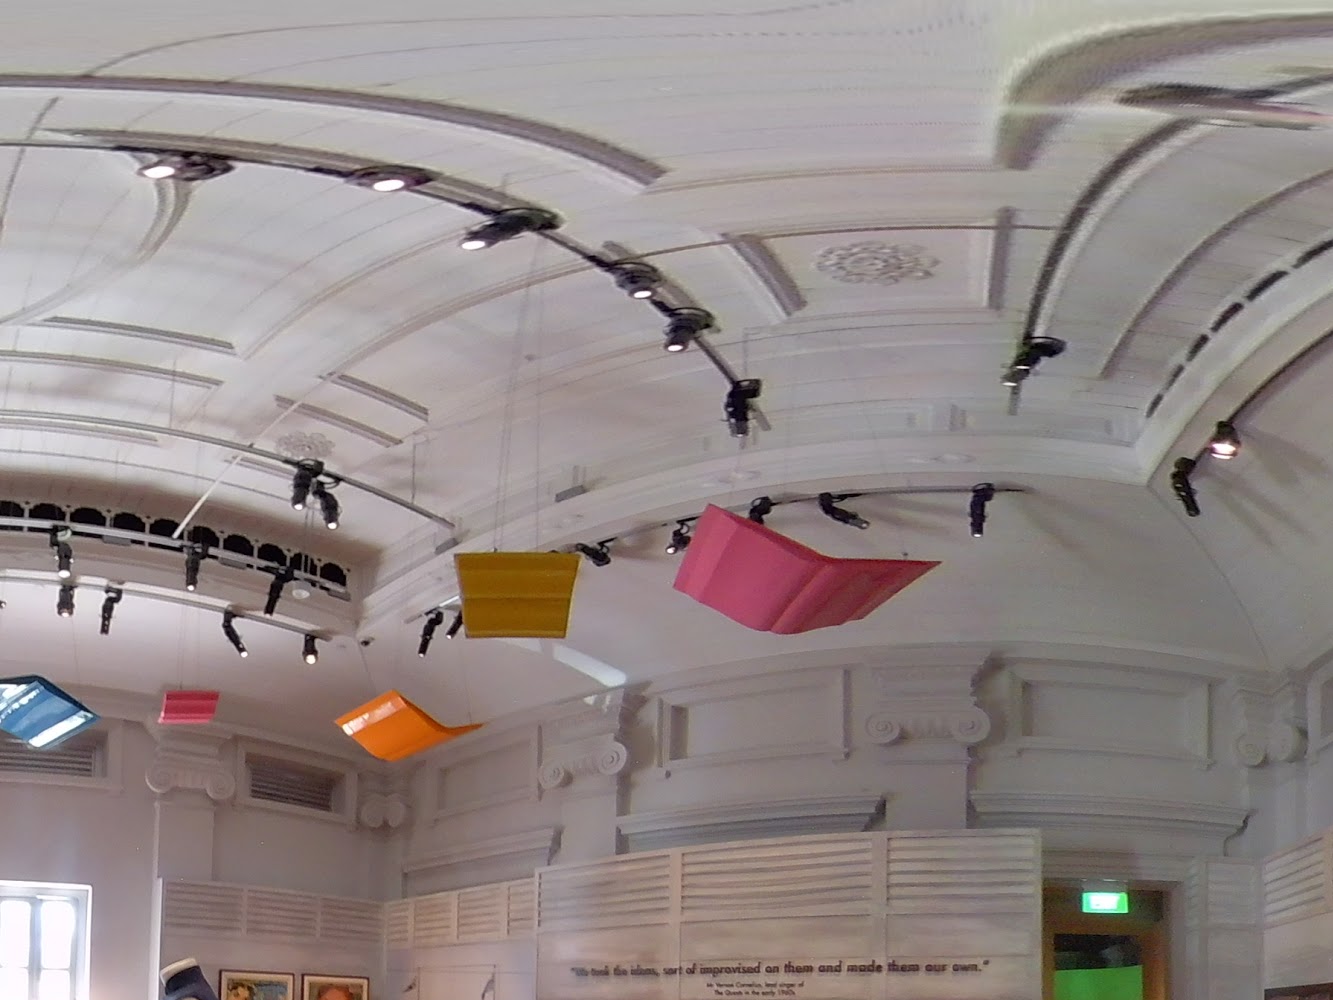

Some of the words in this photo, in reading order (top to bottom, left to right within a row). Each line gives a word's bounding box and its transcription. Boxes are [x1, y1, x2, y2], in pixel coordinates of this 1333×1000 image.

[591, 965, 609, 977] took
[613, 964, 628, 977] the
[663, 965, 682, 975] sort
[685, 963, 697, 975] of
[700, 961, 761, 977] improvised
[764, 965, 780, 974] on
[784, 961, 814, 974] them
[818, 960, 843, 974] and
[847, 960, 883, 973] made
[887, 960, 921, 973] them
[925, 963, 947, 973] our
